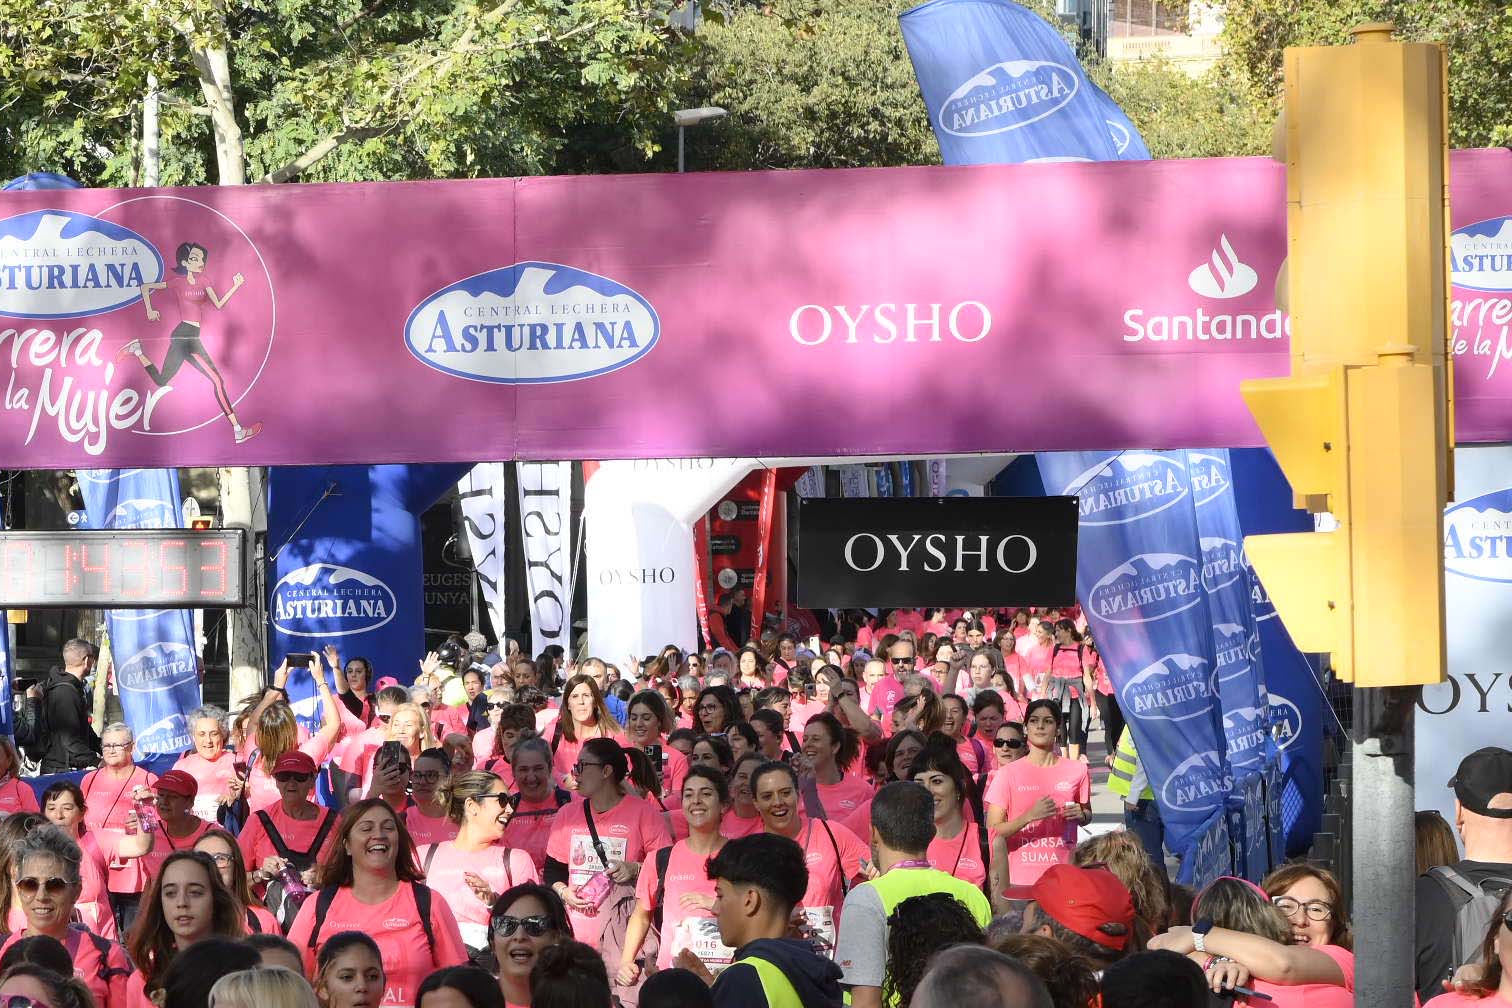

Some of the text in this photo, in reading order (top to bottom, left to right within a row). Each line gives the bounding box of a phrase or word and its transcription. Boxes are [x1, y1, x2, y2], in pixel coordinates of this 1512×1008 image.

[66, 246, 139, 257] LECHERA
[464, 302, 632, 318] CENTRAL LECHERA
[789, 300, 993, 346] OYSHO
[424, 309, 640, 353] ASTURIANA
[1473, 327, 1492, 355] la
[5, 370, 29, 410] la
[24, 363, 174, 456] Mujer
[844, 532, 1038, 574] OYSHO
[599, 567, 675, 584] OYSHO
[287, 588, 383, 597] CENTRAL LECHERA
[275, 593, 388, 620] ASTURIANA
[1021, 851, 1059, 863] SUMA
